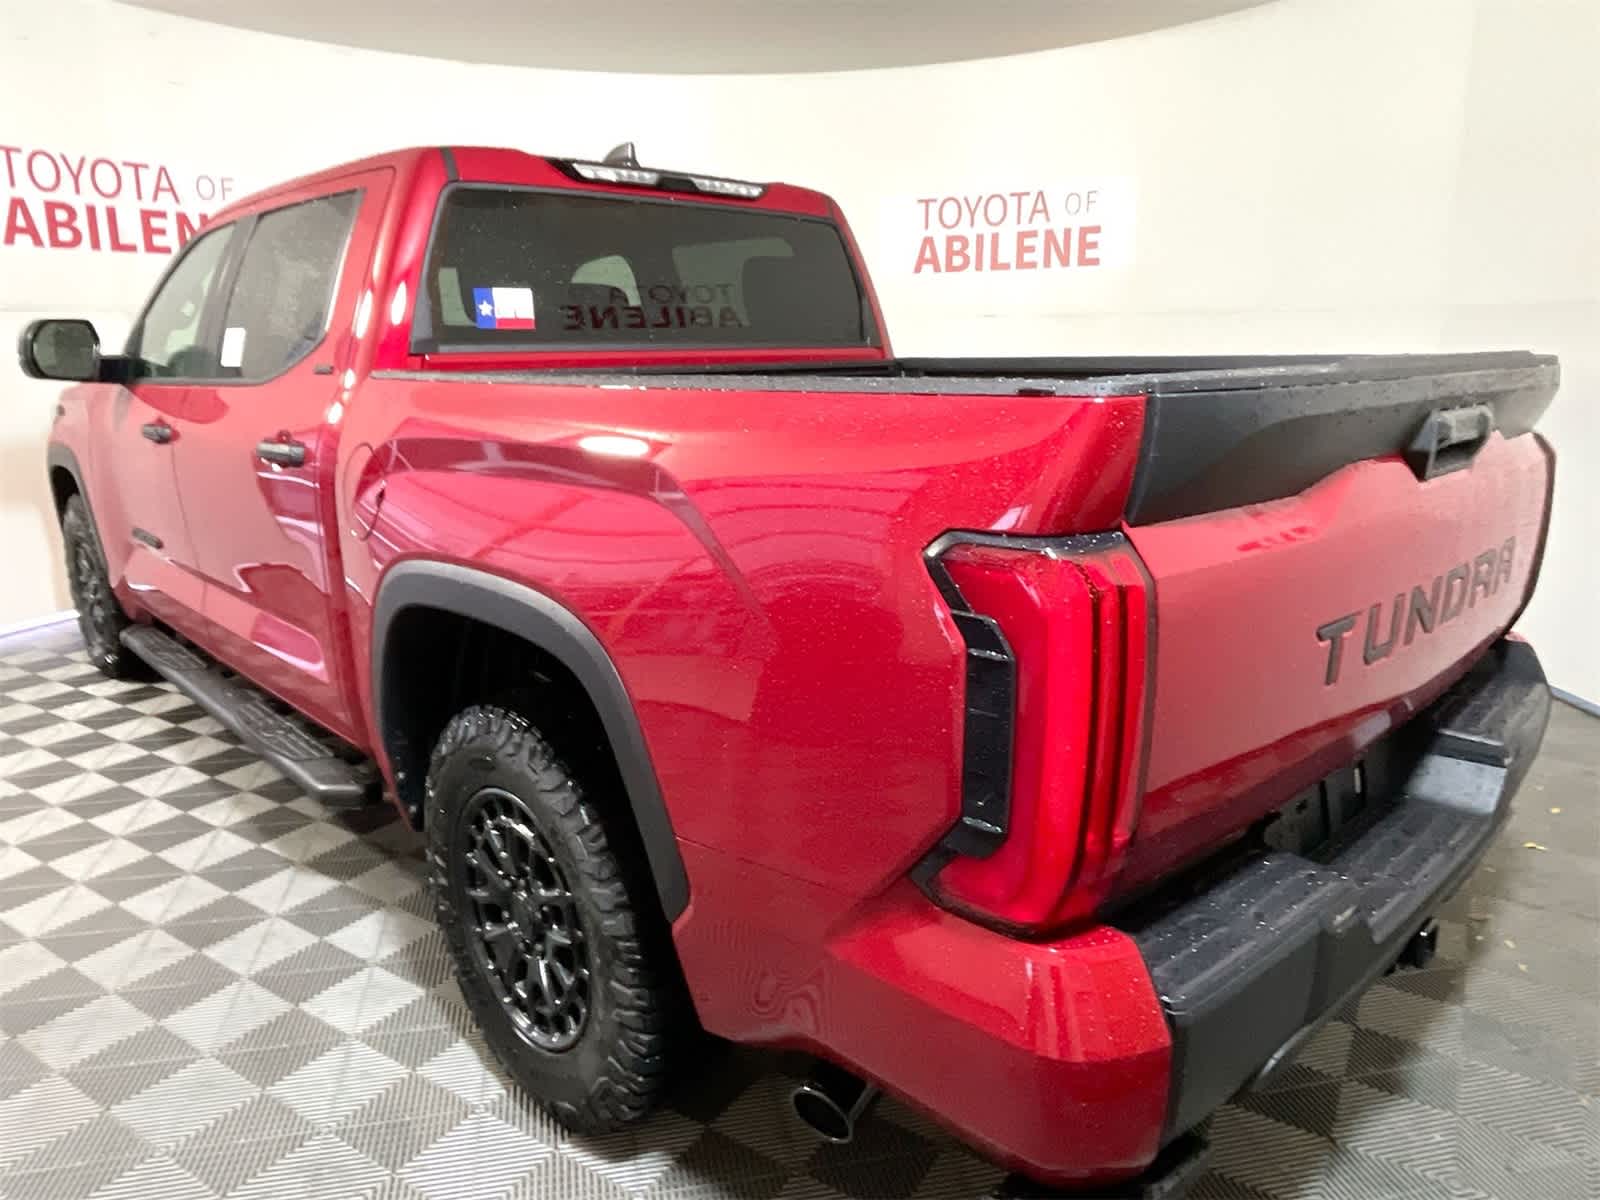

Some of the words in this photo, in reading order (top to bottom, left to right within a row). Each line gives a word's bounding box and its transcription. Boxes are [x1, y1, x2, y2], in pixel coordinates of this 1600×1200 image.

[0, 145, 181, 204] TOYOTA
[196, 174, 234, 201] OF
[4, 197, 208, 254] ABILEN
[917, 190, 1050, 230] TOYOTA
[1065, 190, 1099, 216] OF
[913, 225, 1102, 274] ABILENE
[1316, 536, 1516, 686] TUNDRA
